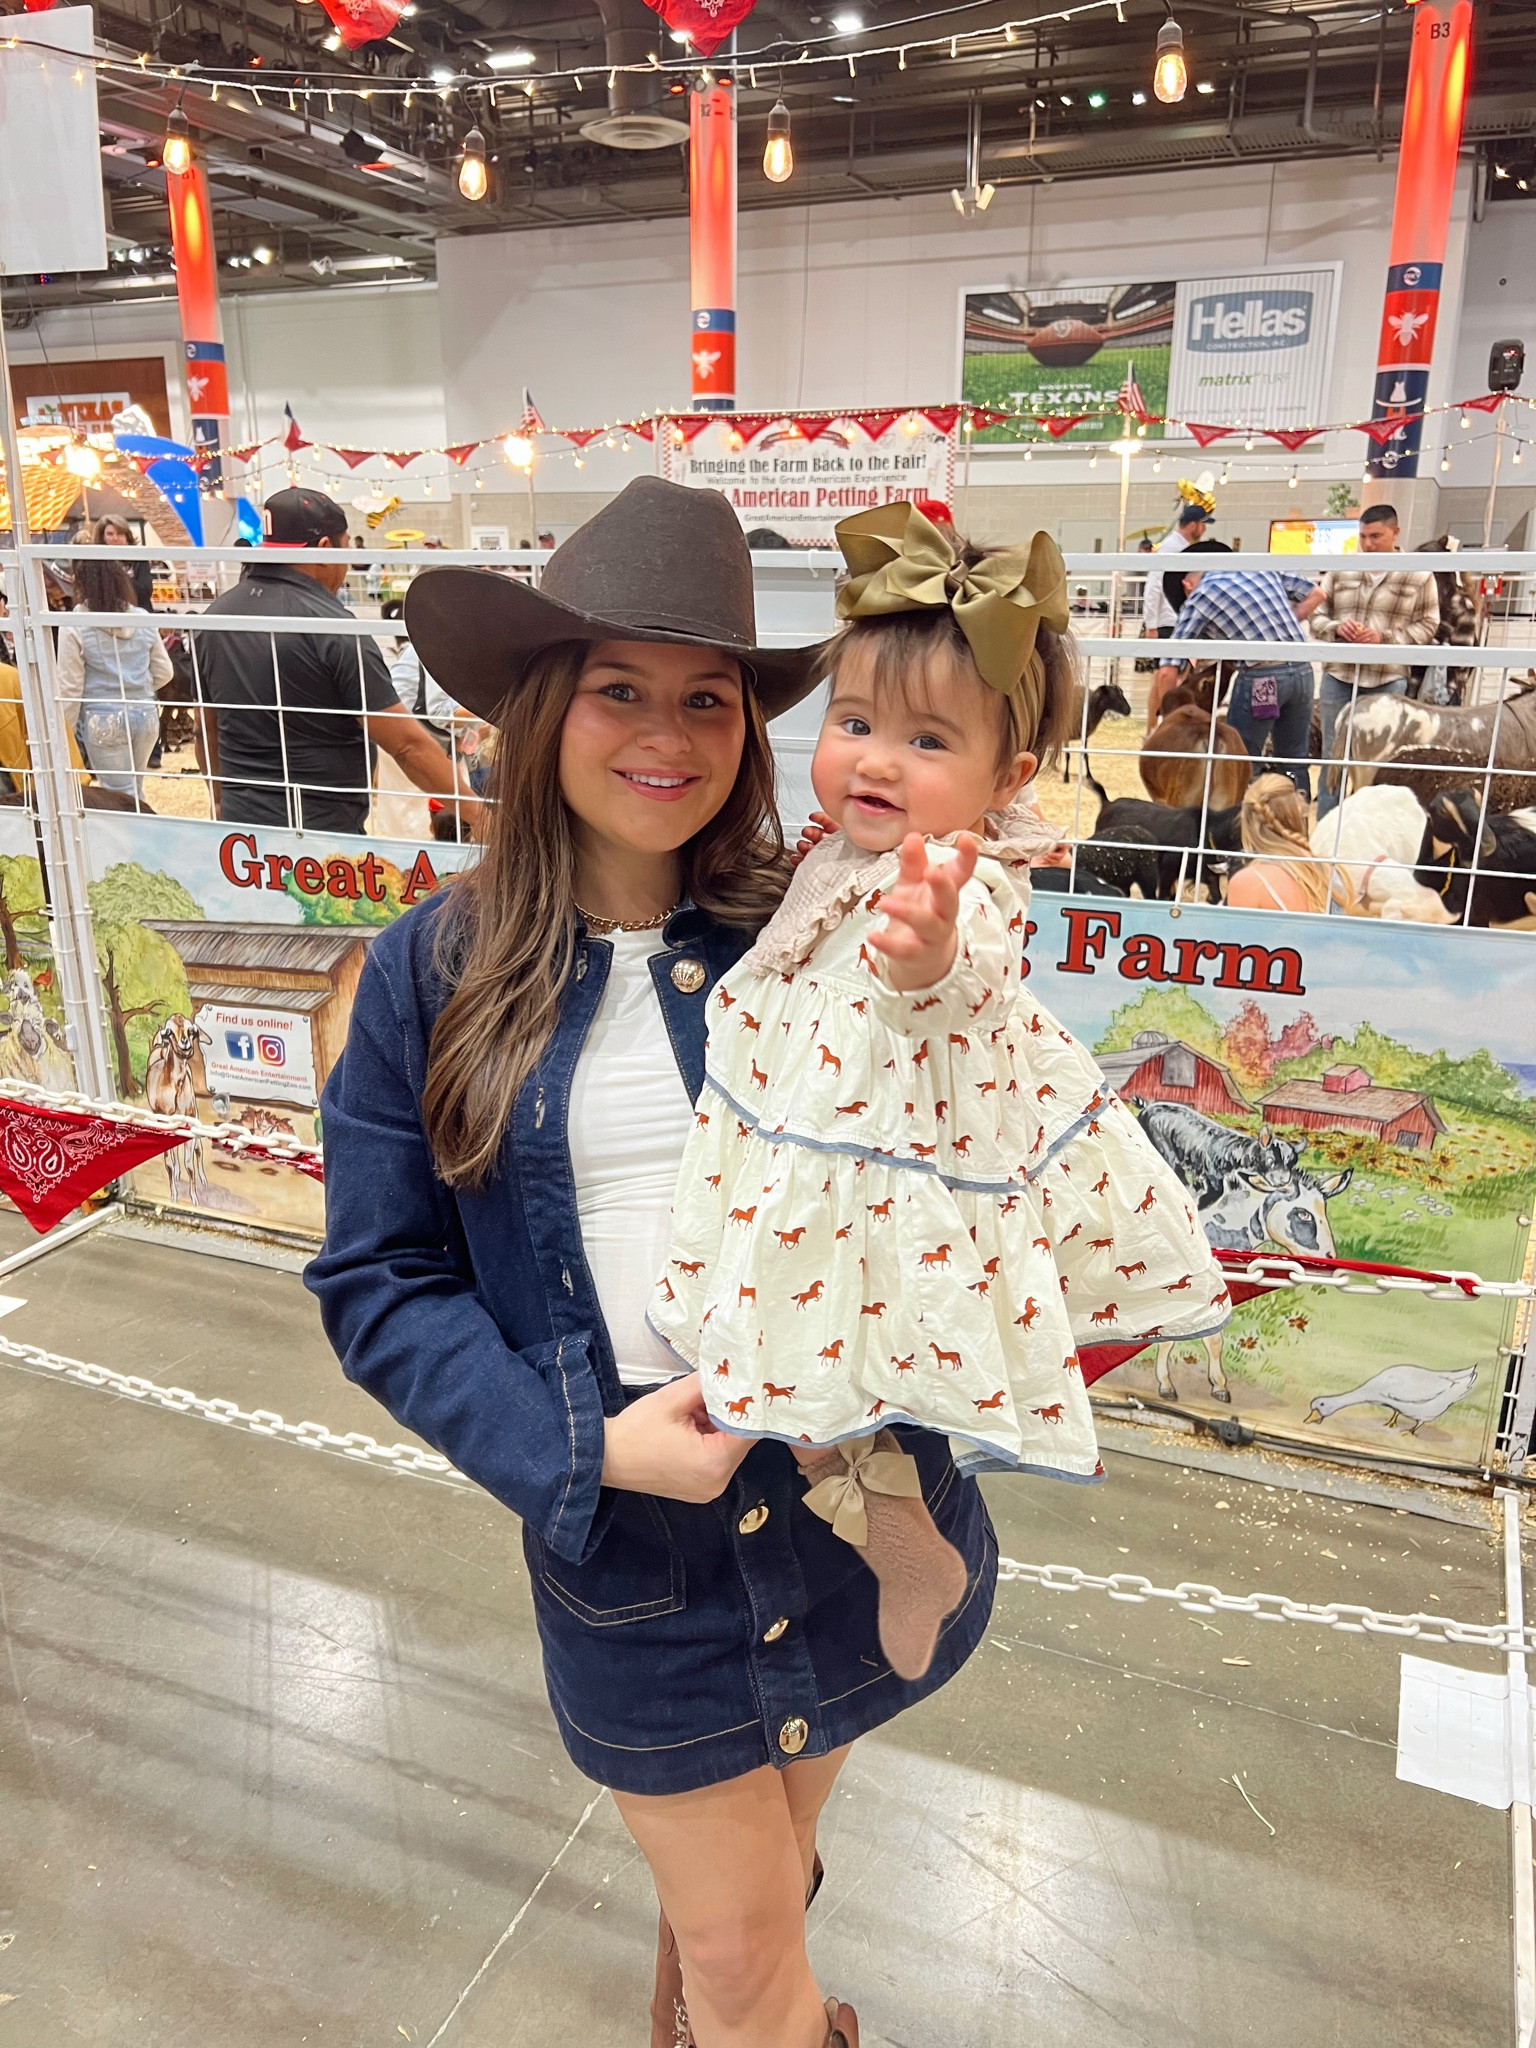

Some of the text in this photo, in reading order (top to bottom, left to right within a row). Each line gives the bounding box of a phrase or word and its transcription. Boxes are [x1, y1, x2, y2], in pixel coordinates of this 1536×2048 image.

[1430, 22, 1451, 39] B3
[1190, 299, 1307, 341] Hellas
[1198, 371, 1253, 387] matrix
[1008, 390, 1120, 406] TEXANS
[690, 454, 927, 475] Bringing the Farm Back to the Fair!
[854, 473, 907, 483] Experience
[732, 485, 929, 508] American Petting Farm
[219, 833, 386, 902] Great
[1056, 908, 1306, 996] Farm
[216, 1012, 293, 1030] Find us online!
[211, 1062, 308, 1083] Great American Entertainment
